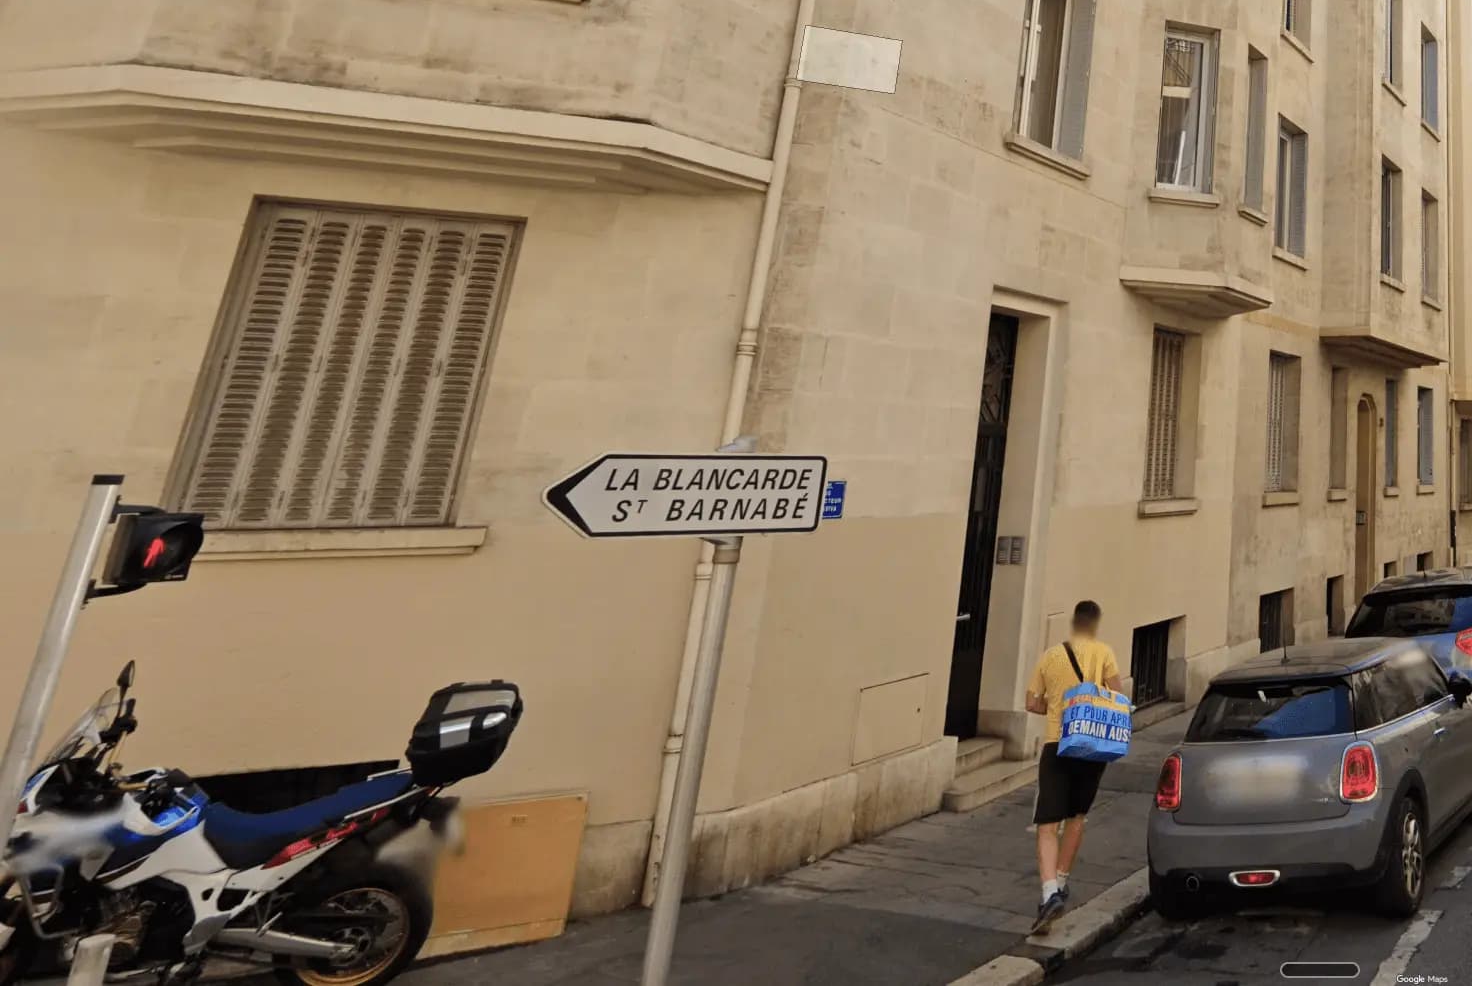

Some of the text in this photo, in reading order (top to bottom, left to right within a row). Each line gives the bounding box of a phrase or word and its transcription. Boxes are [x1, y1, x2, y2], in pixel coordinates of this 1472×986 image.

[604, 468, 639, 491] LA
[652, 468, 813, 491] BLANCARDE
[665, 492, 808, 522] BARNABÉ
[1084, 705, 1108, 722] POUR
[1068, 719, 1107, 739] DEMAIN
